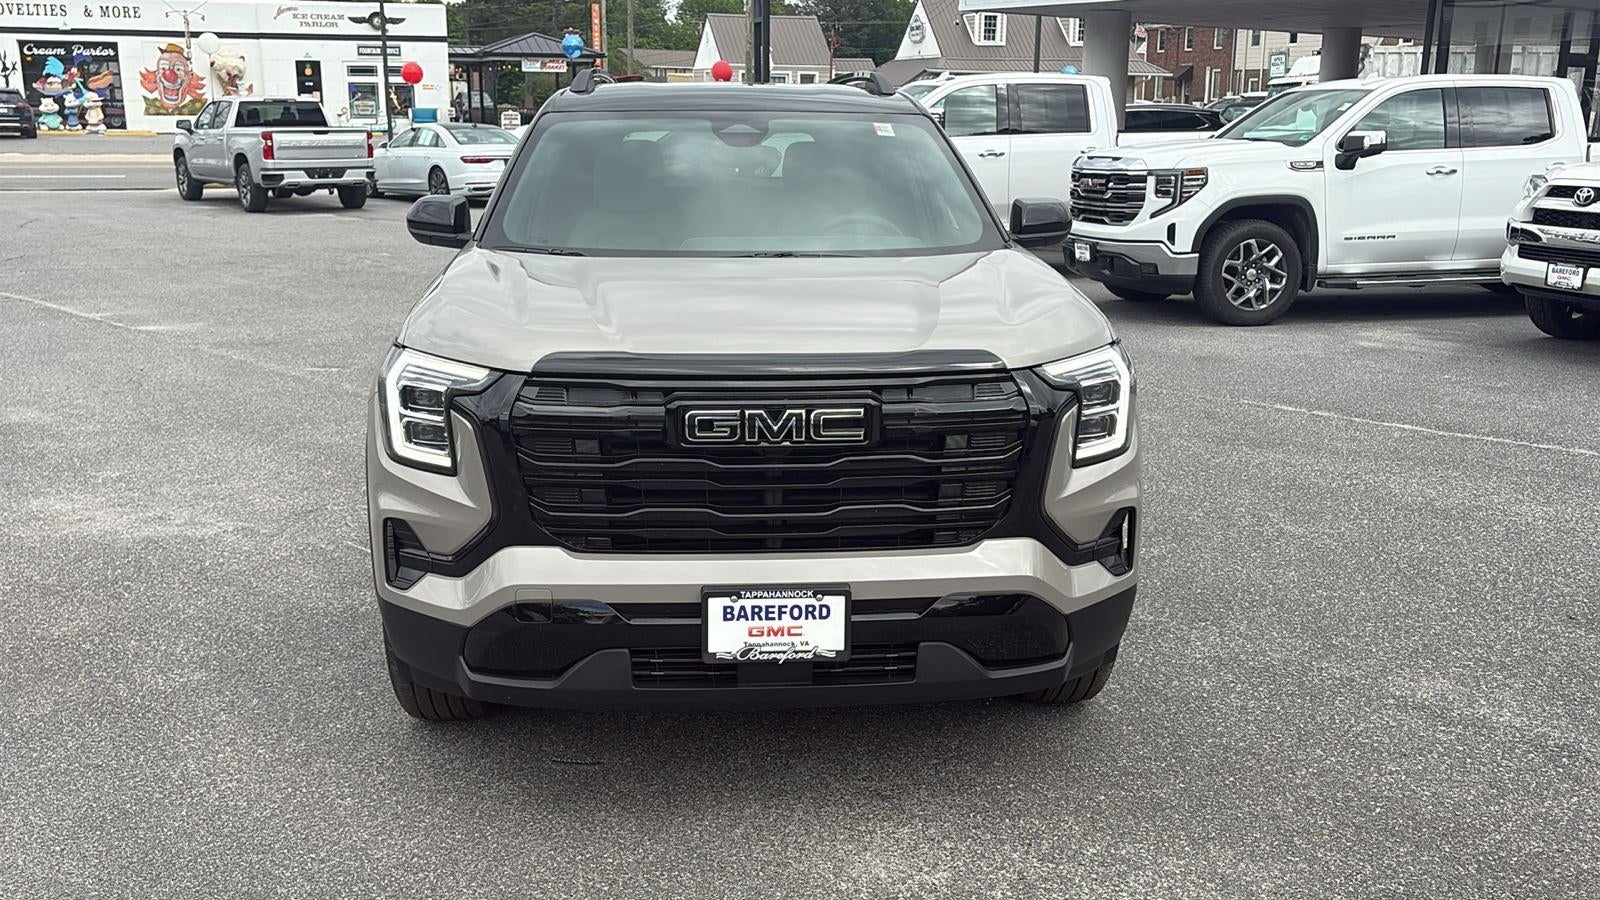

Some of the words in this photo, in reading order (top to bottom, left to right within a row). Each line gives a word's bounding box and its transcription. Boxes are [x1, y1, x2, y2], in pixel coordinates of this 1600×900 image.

[83, 4, 94, 18] &
[98, 5, 142, 19] MORE
[23, 43, 67, 55] Cream
[72, 44, 117, 56] Parlor
[1551, 267, 1580, 277] BAREFORD
[685, 408, 865, 442] GMC
[740, 590, 814, 599] TAPPAHANNOCK
[722, 604, 831, 622] BAREFORD
[747, 625, 803, 637] GMC
[736, 646, 819, 664] Bareford
